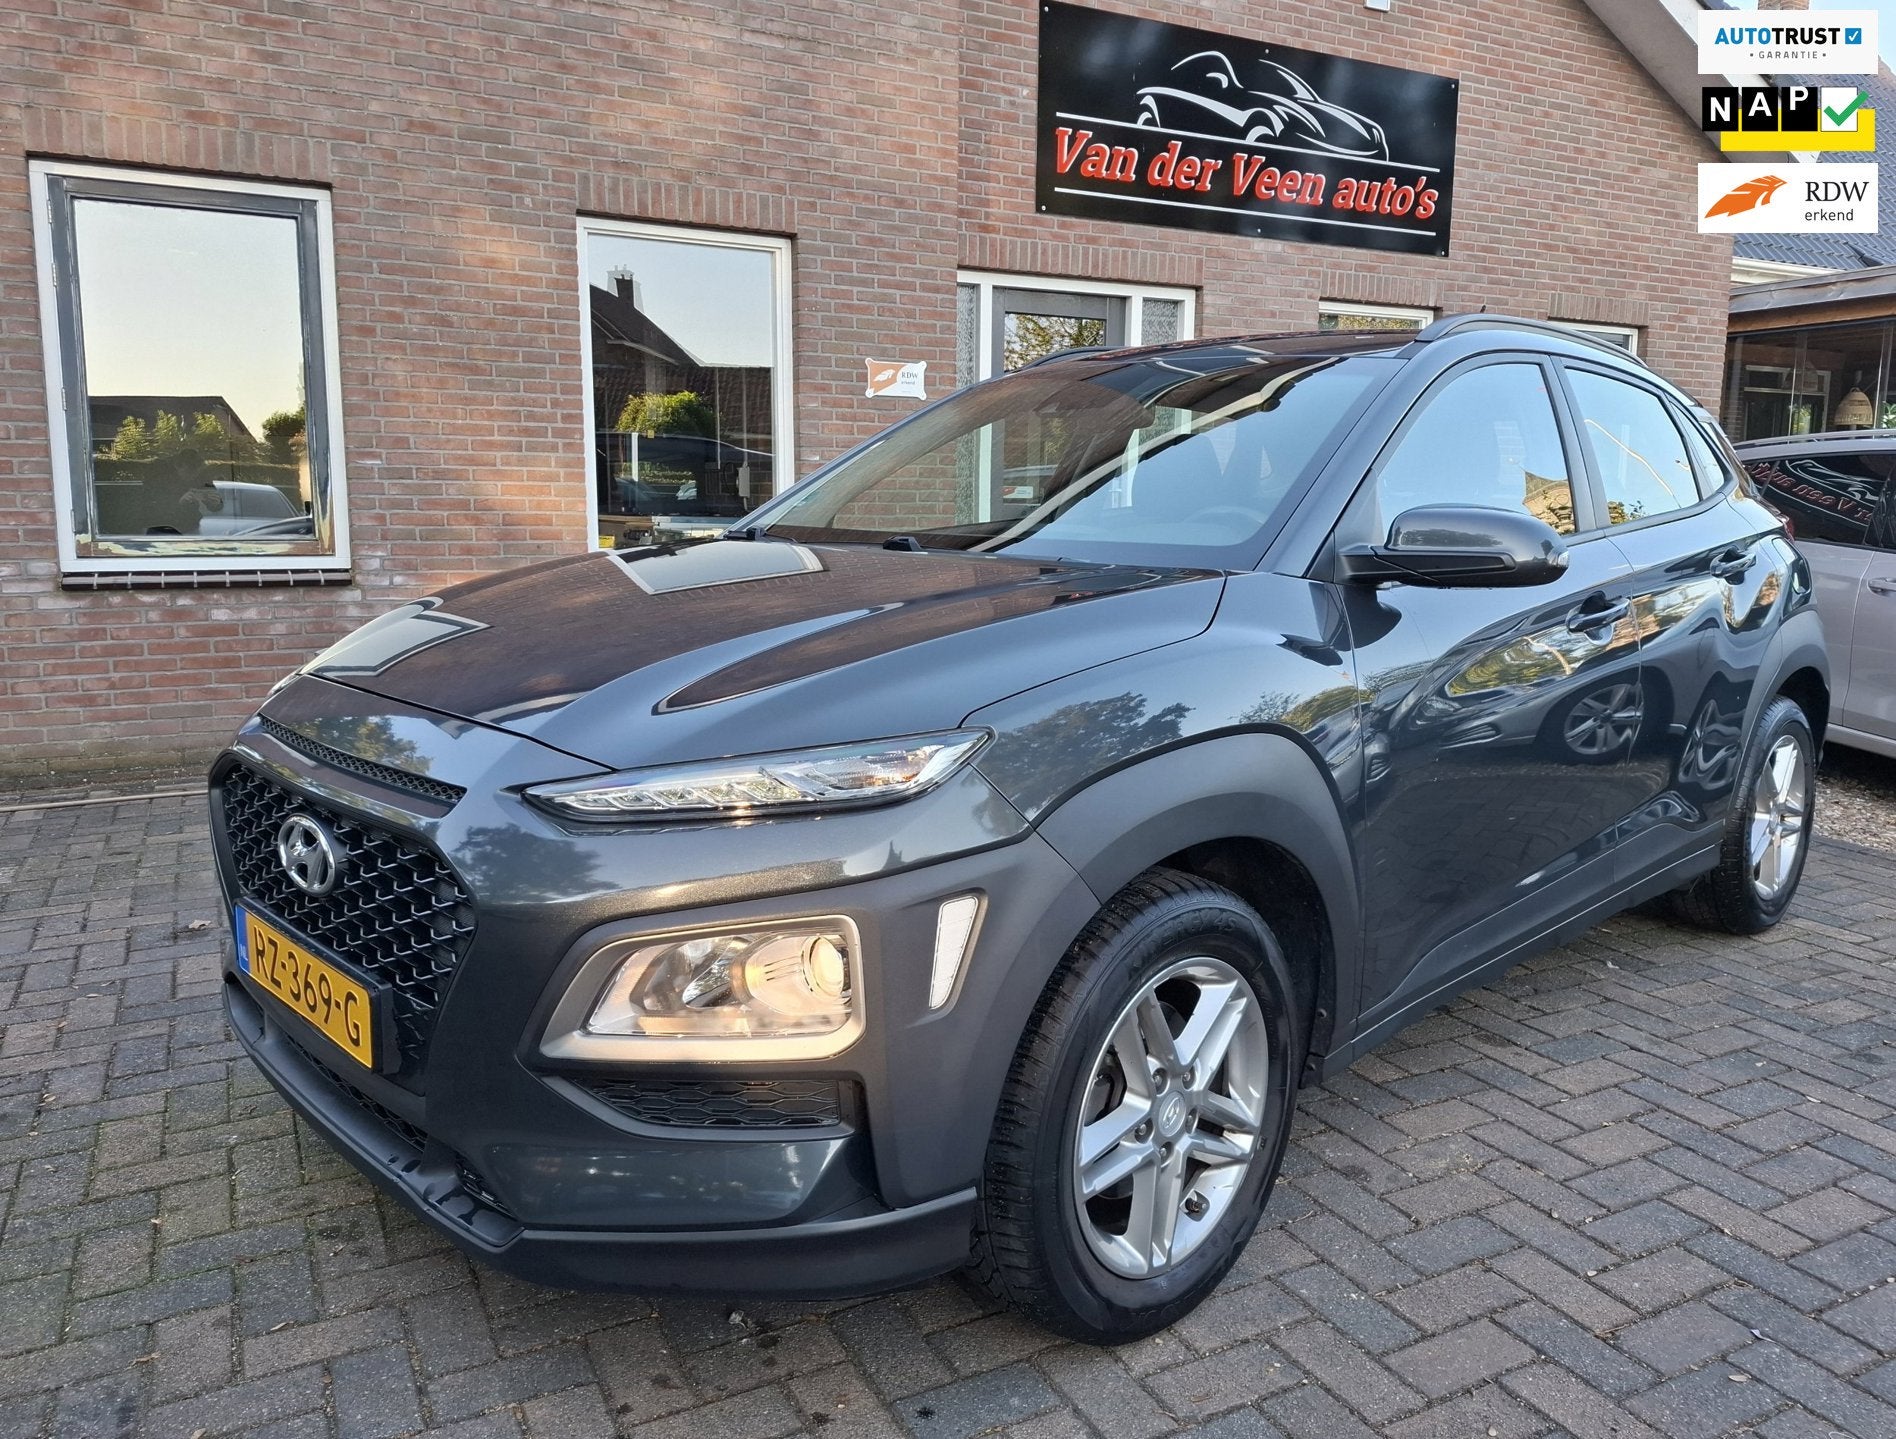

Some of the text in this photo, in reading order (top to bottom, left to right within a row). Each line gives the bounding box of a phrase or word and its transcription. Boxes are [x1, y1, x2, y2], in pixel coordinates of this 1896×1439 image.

[1054, 126, 1439, 220] Van der Veen auto's
[901, 371, 918, 379] RDW
[254, 925, 361, 1047] RZ-369-G
